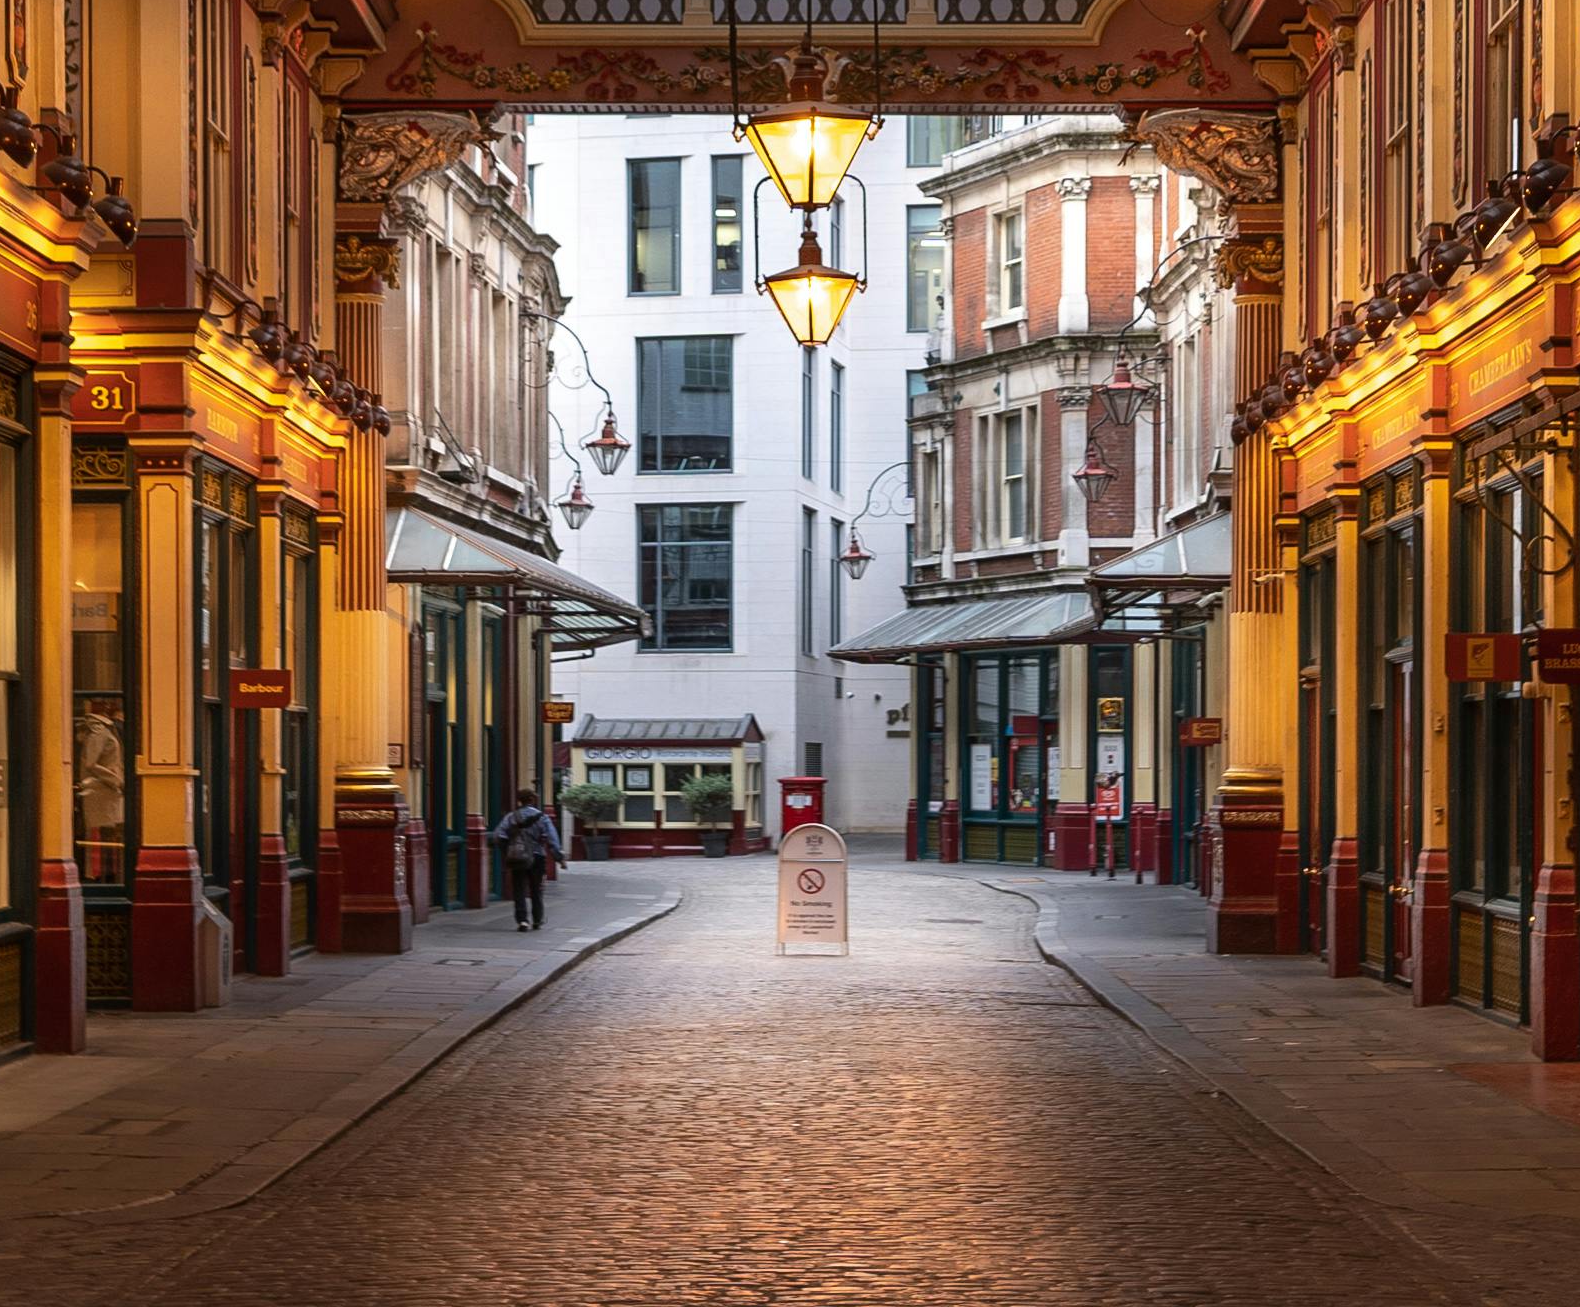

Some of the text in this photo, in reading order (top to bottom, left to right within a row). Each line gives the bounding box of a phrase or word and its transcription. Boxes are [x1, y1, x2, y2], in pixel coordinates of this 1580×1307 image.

[91, 386, 124, 410] 31
[239, 682, 284, 693] Barbour
[585, 746, 652, 760] GIORGIO
